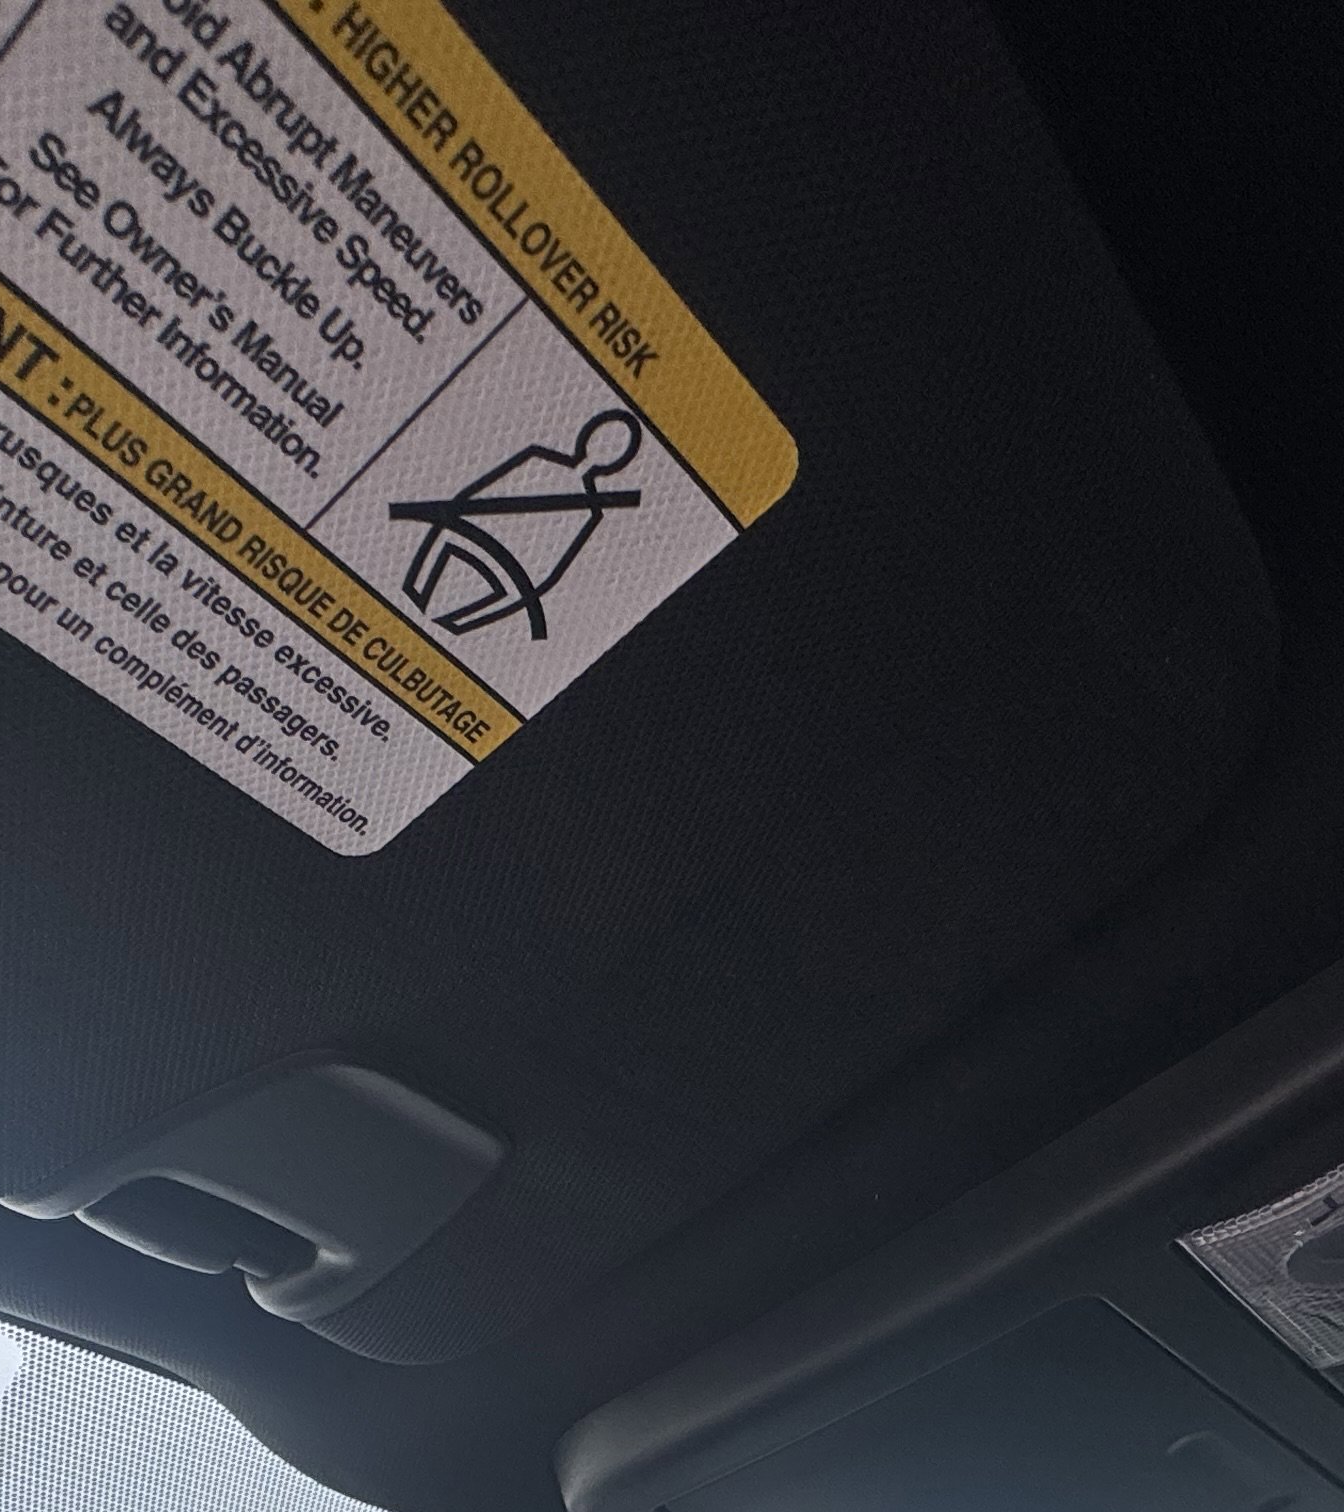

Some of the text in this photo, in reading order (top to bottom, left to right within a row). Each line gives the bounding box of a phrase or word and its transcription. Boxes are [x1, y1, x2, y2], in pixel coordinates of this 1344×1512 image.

[29, 134, 100, 209] See
[232, 319, 345, 428] Manual
[86, 93, 364, 371] Always Buckle Up.
[104, 2, 433, 345] and Excessive Speed.
[218, 41, 338, 169] Abrupt
[330, 153, 484, 326] Maneuvers
[332, 7, 659, 379] HIGHER ROLLOVER RISK
[35, 208, 162, 328] Further
[157, 316, 321, 479] Information.
[56, 607, 94, 642] un
[94, 636, 239, 741] complément
[63, 392, 148, 467] PLUS
[146, 459, 243, 543] GRAND
[238, 535, 335, 618] RISQUE
[327, 608, 369, 646] DE
[362, 637, 491, 744] CULBUTAGE
[73, 557, 108, 588] et
[106, 581, 171, 633] celle
[171, 630, 221, 670] des
[214, 665, 340, 761] passagers.
[115, 522, 150, 553] et
[148, 541, 179, 577] la
[181, 570, 274, 648] vitesse
[274, 645, 390, 743] excessive.
